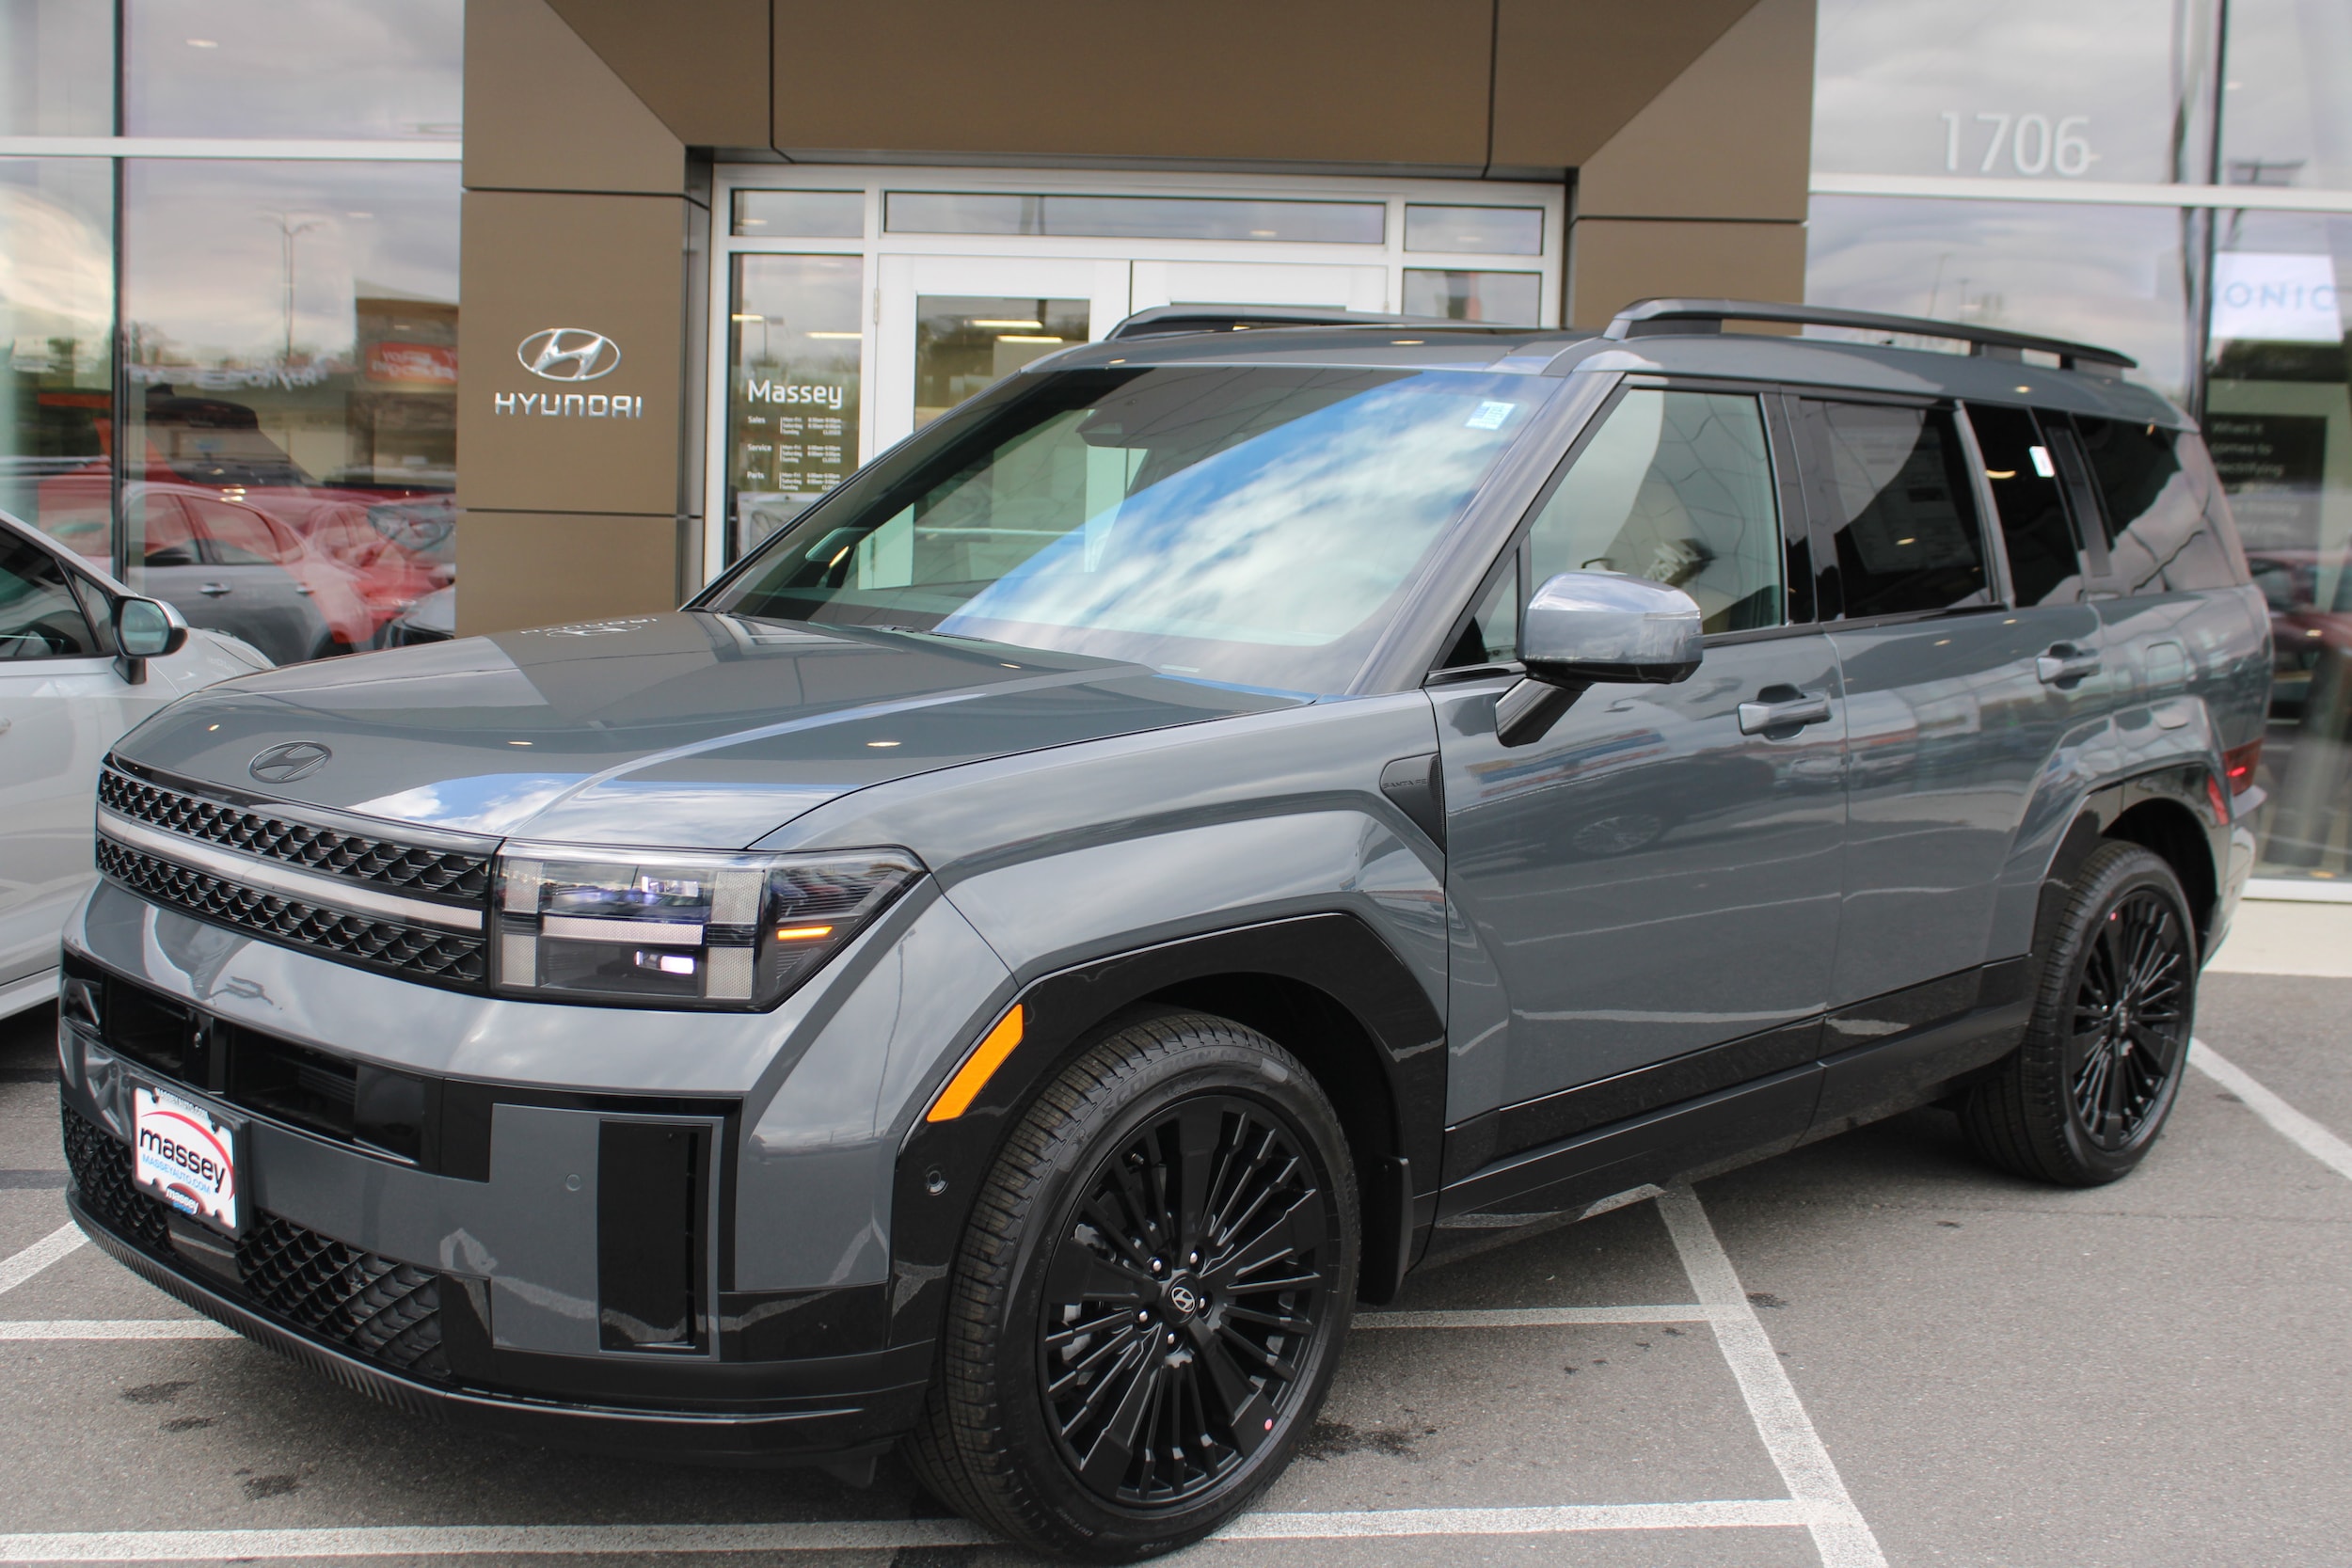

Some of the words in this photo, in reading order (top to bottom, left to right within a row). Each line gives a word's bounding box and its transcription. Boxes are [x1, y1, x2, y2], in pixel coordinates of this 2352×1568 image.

[1938, 111, 2091, 178] 1706
[494, 392, 643, 419] HYUNDAI
[748, 379, 843, 410] Massey
[748, 416, 766, 425] Sales
[748, 444, 772, 452] Service
[747, 471, 765, 480] Parts
[1383, 780, 1414, 789] SANTA
[140, 1128, 226, 1194] massey
[143, 1154, 210, 1194] MASSEYAUTO.COM
[166, 1187, 199, 1215] massey
